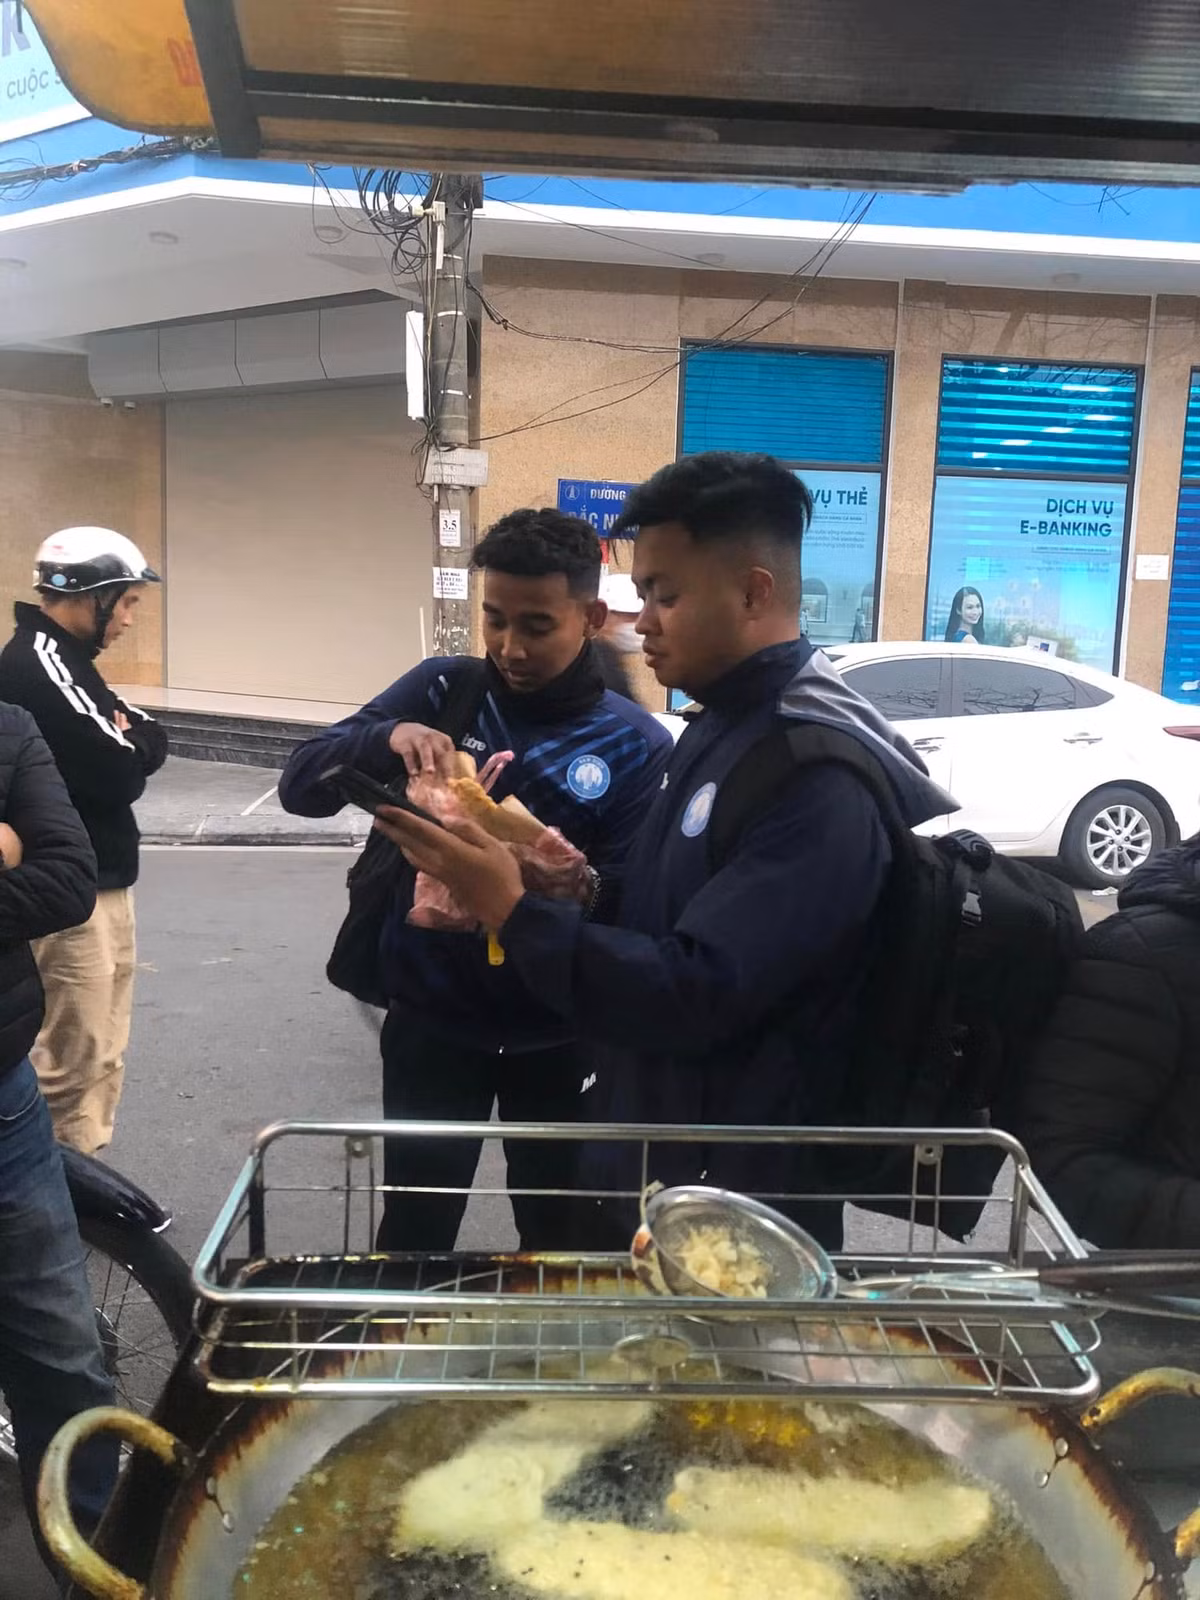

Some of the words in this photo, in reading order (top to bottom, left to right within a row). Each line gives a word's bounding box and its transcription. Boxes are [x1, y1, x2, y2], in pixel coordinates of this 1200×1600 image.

[809, 489, 832, 508] VỤ
[836, 486, 868, 505] THẺ
[568, 504, 598, 529] ẮC
[1046, 498, 1087, 517] DỊCH
[1091, 500, 1114, 519] VỤ
[442, 519, 457, 531] 3.5
[1020, 520, 1112, 537] E-BANKING
